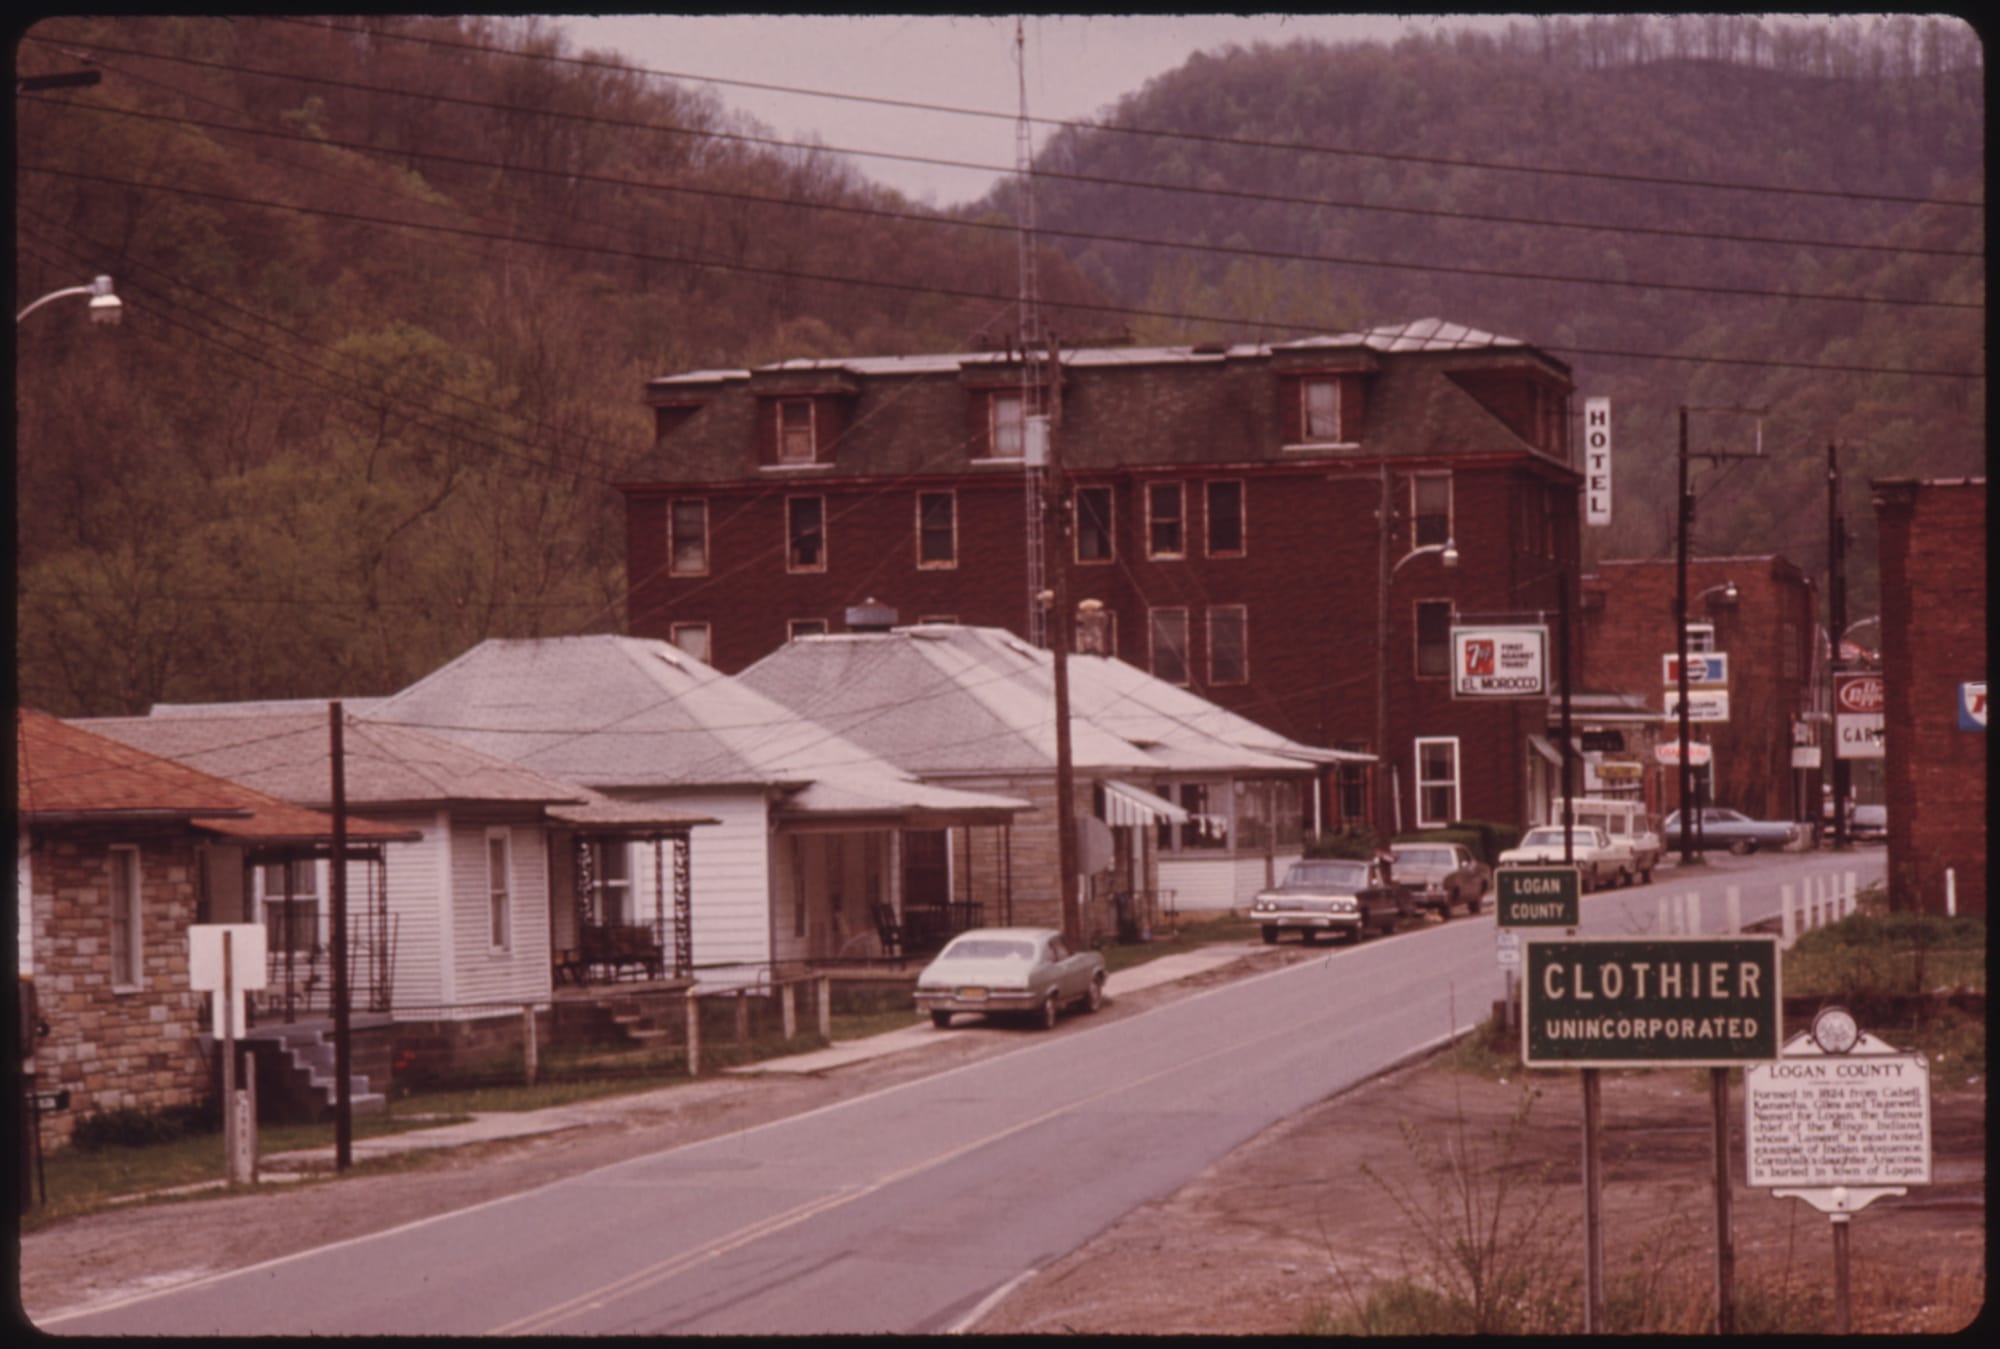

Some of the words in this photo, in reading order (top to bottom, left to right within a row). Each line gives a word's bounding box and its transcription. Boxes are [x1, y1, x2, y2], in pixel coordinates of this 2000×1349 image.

[1590, 410, 1606, 513] HOTEL
[1462, 678, 1478, 690] EL
[1481, 676, 1537, 689] MOROCCO
[1514, 878, 1561, 894] LOGAN
[1511, 903, 1564, 919] COUNTY
[1544, 962, 1760, 999] CLOTHIER
[1546, 1017, 1758, 1039] UNINCORPORATED
[1769, 1065, 1825, 1078] LOGAN
[1837, 1064, 1904, 1077] COUNTY
[1753, 1089, 1797, 1099] Formed
[1803, 1088, 1813, 1098] in
[1819, 1088, 1843, 1098] 1824
[1850, 1088, 1877, 1098] from
[1845, 1099, 1866, 1108] and
[1754, 1111, 1792, 1120] Named
[1797, 1110, 1811, 1120] for
[1861, 1109, 1877, 1119] the
[1883, 1109, 1922, 1119] famous
[1754, 1121, 1783, 1131] chief
[1788, 1121, 1800, 1131] of
[1808, 1121, 1826, 1131] the
[1832, 1121, 1868, 1132] Mingo
[1755, 1133, 1789, 1143] whose
[1847, 1132, 1856, 1141] is
[1860, 1132, 1887, 1141] most
[1890, 1131, 1922, 1141] noted
[1755, 1145, 1803, 1155] example
[1807, 1144, 1818, 1154] of
[1823, 1144, 1858, 1153] Indian
[1819, 1155, 1866, 1166] daughter
[1755, 1168, 1764, 1177] is
[1771, 1167, 1808, 1177] buried
[1815, 1167, 1826, 1176] in
[1833, 1167, 1860, 1176] town
[1866, 1166, 1878, 1176] of
